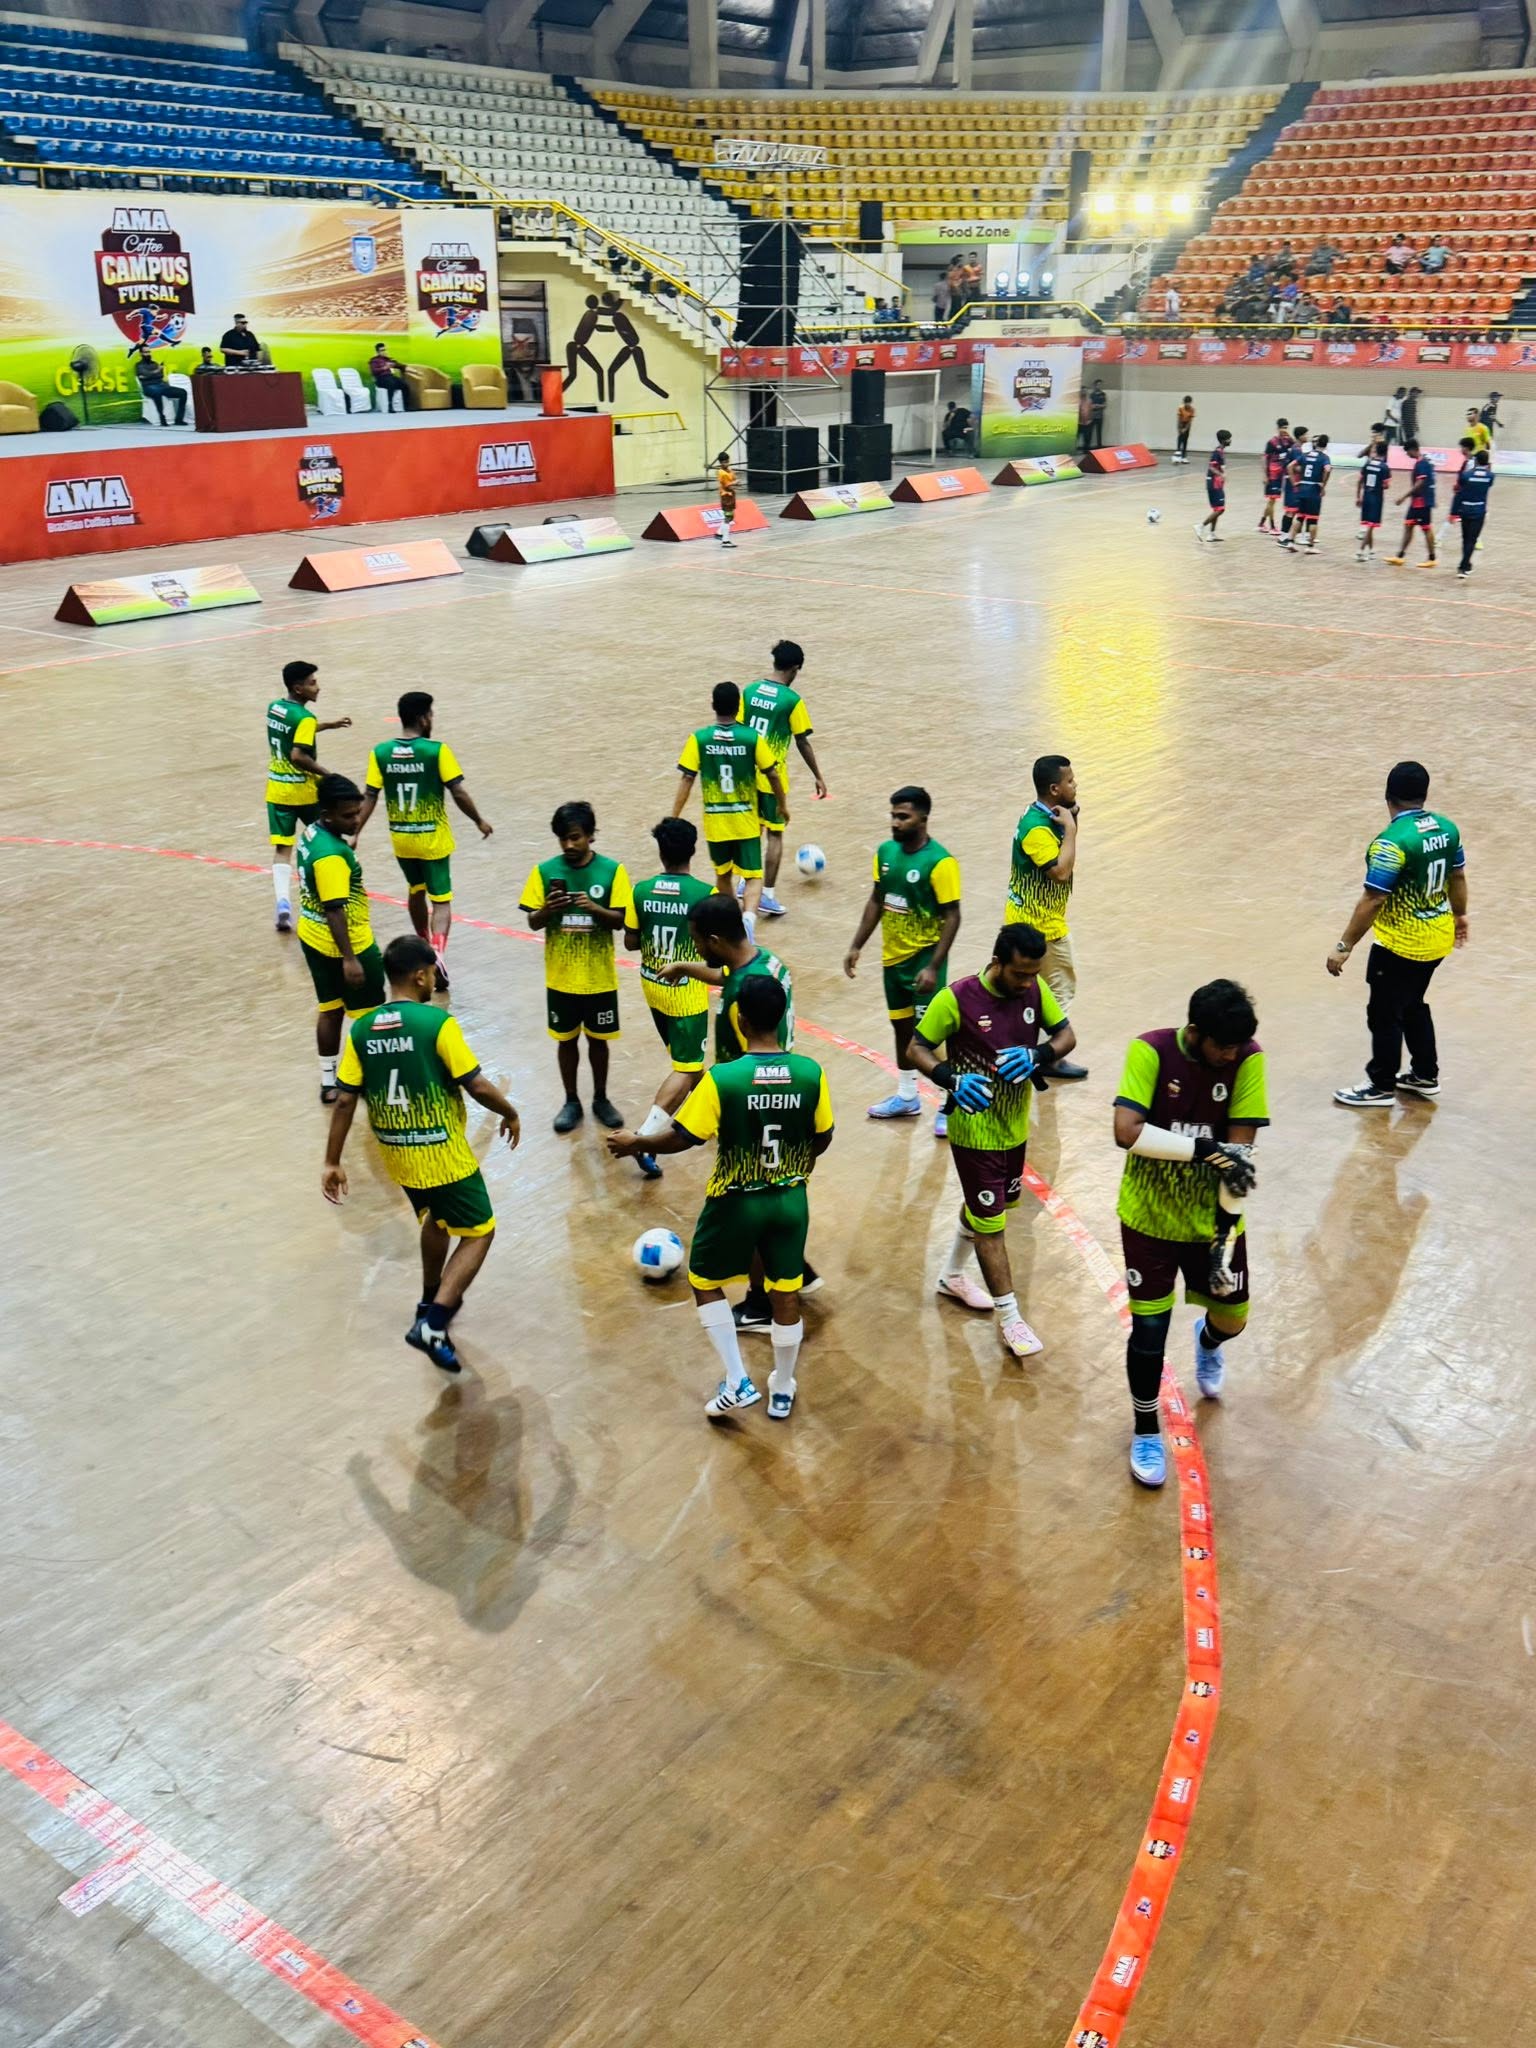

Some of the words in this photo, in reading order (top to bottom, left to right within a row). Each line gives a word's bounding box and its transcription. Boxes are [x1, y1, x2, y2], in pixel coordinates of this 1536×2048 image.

[112, 208, 171, 232] AMA
[939, 226, 972, 238] Food
[976, 226, 1010, 237] Zone
[122, 235, 163, 257] Coffee
[429, 243, 473, 259] AMA
[101, 255, 190, 286] CAMPUS
[419, 273, 485, 293] CAMPUS
[119, 284, 180, 304] FUTSAL
[431, 292, 477, 304] FUTSAL
[479, 442, 536, 473] AMA
[47, 476, 133, 517] AMA
[750, 696, 777, 711] BABY
[705, 744, 747, 756] SHANTO
[386, 762, 425, 774] ARMAN
[719, 764, 735, 793] 8
[397, 782, 418, 812] 17
[1423, 833, 1450, 853] ARIF
[1426, 858, 1446, 900] 10
[643, 900, 689, 916] ROHAN
[597, 1010, 613, 1025] 69
[366, 1036, 414, 1055] SIYAM
[754, 1066, 791, 1078] AMA
[386, 1068, 410, 1112] 4
[747, 1094, 801, 1110] ROBIN
[1170, 1120, 1213, 1139] AMA
[759, 1124, 782, 1168] 5
[1112, 1955, 1134, 1984] AMA
